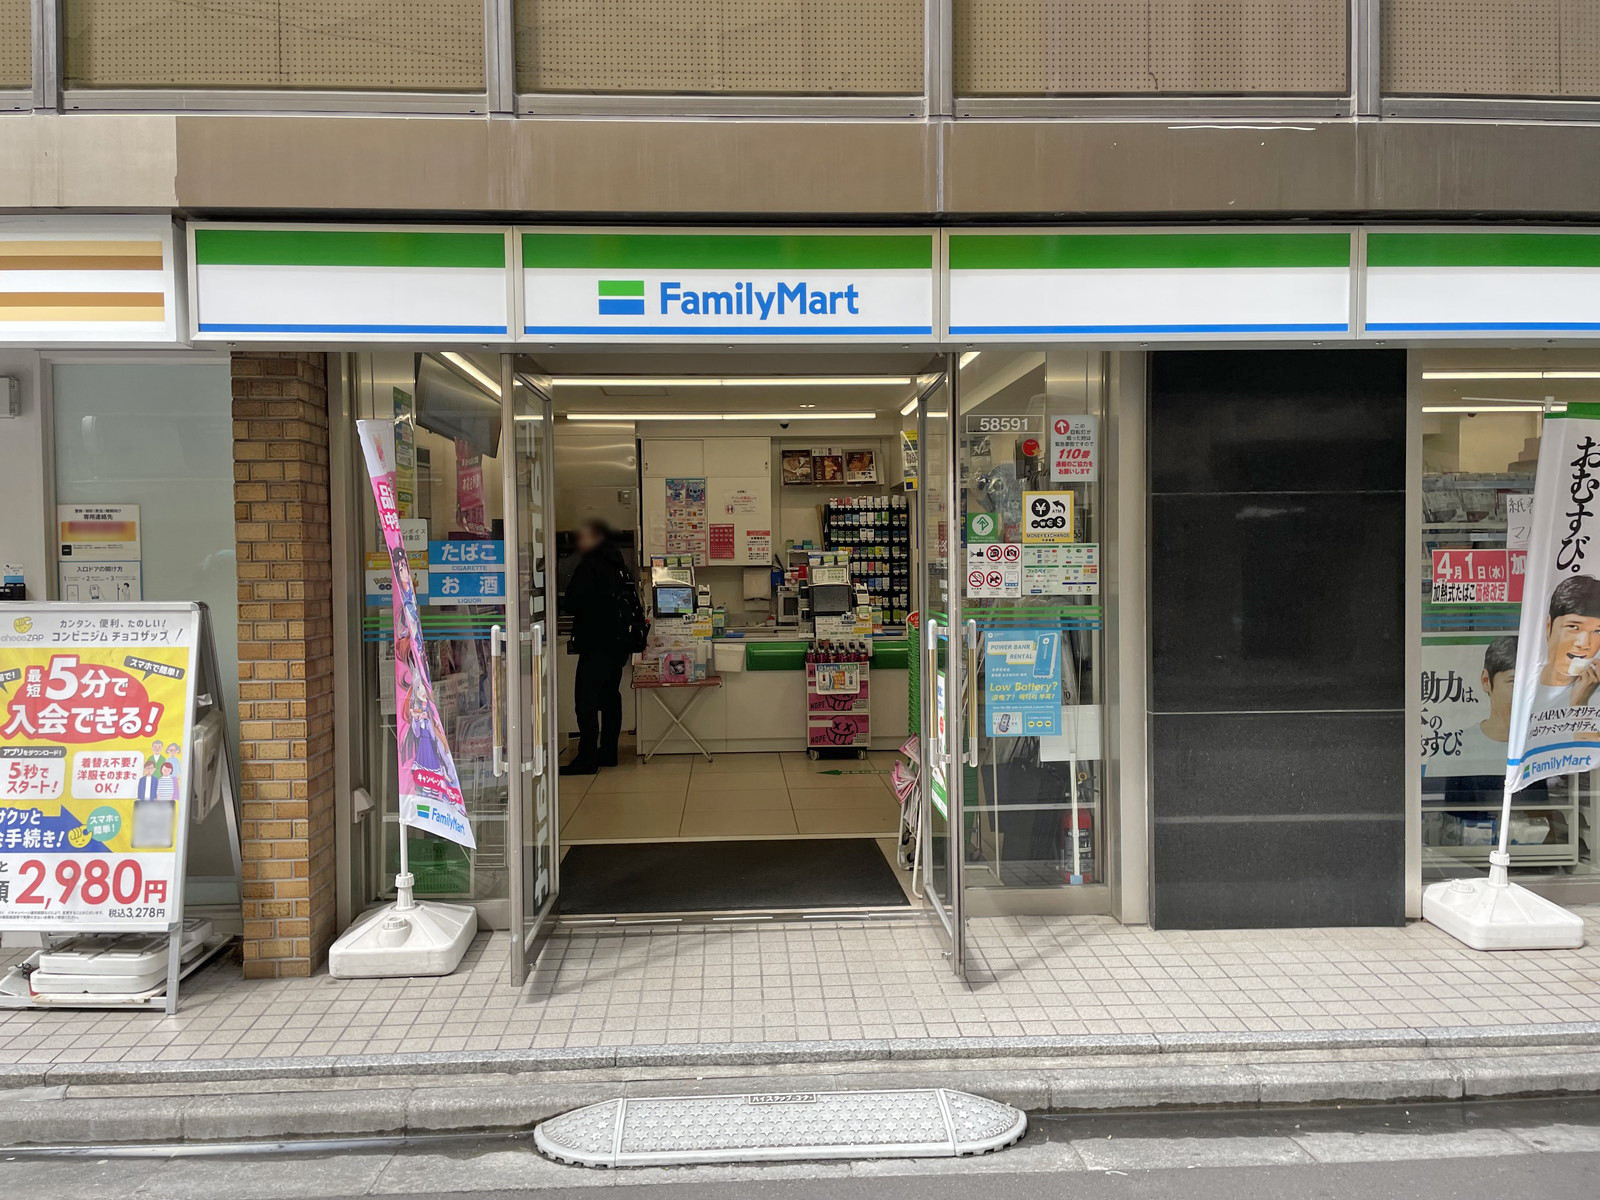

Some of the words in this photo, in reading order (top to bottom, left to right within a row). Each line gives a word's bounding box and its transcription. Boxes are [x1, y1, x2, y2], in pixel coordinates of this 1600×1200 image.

[660, 282, 859, 320] FamilyMart
[980, 418, 1028, 431] 58591
[1059, 448, 1091, 459] 110番
[1556, 436, 1600, 573] おむすび。
[441, 544, 496, 561] たばこ
[442, 577, 460, 595] お
[479, 576, 498, 595] 酒
[60, 619, 167, 628] カンタン、便利、たのしい!
[52, 632, 109, 642] コンビニジム
[112, 630, 169, 642] チョコザップ
[130, 658, 180, 677] スマホで簡単!
[990, 683, 1012, 691] Low
[1015, 681, 1058, 692] Battery?
[4, 704, 160, 737] 入会できる!
[811, 734, 826, 743] NOPE
[3, 748, 63, 757] アプリをダウンロード!
[82, 757, 138, 769] 着替え不要!
[1531, 754, 1591, 774] FamilyMart
[8, 762, 49, 780] 5秒で
[77, 770, 138, 780] 洋服そのままで
[7, 780, 59, 794] スタート!
[95, 783, 120, 793] OK!
[90, 815, 120, 824] スマホで
[432, 808, 465, 835] FamilyMart
[93, 825, 116, 835] 簡単!
[0, 829, 65, 848] 手続き!
[15, 859, 168, 909] 2,980円
[108, 907, 165, 918] 税込3,278円
